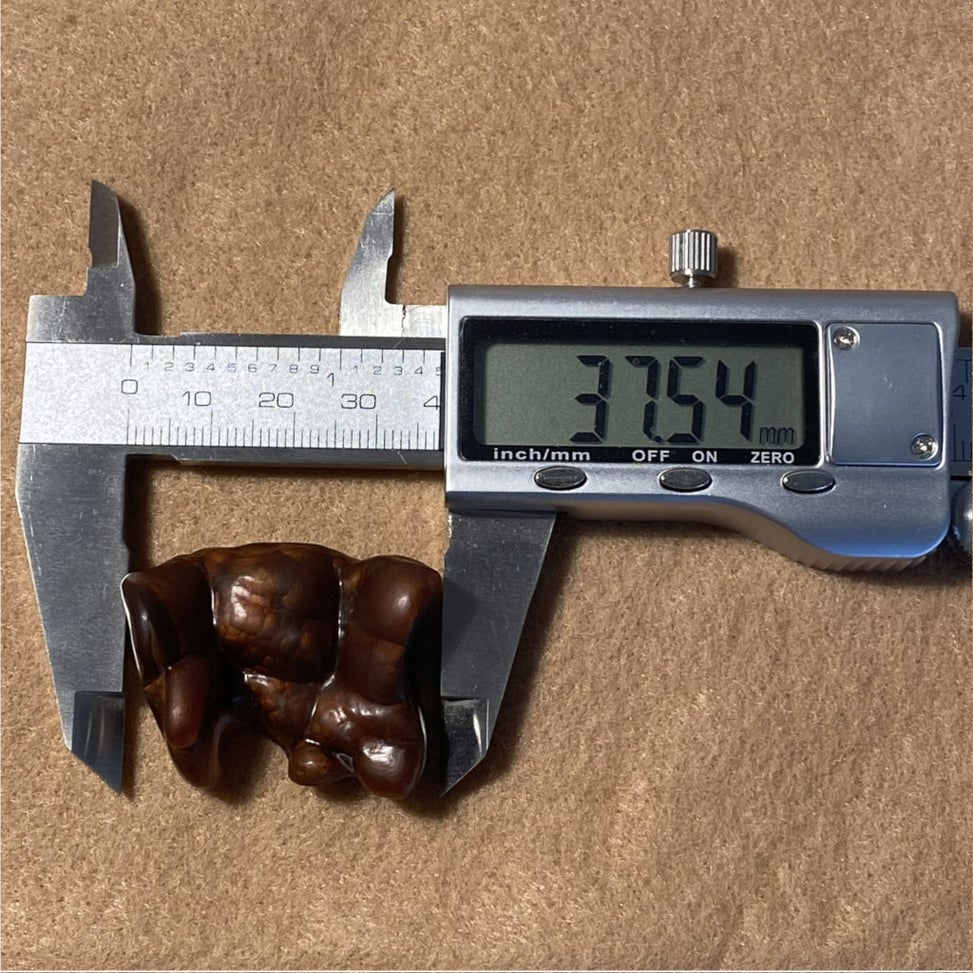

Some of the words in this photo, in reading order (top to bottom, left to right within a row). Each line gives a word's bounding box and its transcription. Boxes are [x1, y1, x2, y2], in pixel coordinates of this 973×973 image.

[121, 379, 138, 394] 0
[182, 390, 211, 407] 10
[259, 393, 294, 408] 20
[341, 394, 376, 409] 30
[570, 355, 756, 444] 37.54
[758, 424, 794, 445] mm
[493, 448, 590, 461] inch/mm
[631, 450, 670, 462] OFF
[692, 450, 718, 462] ON
[750, 451, 794, 464] ZERO
